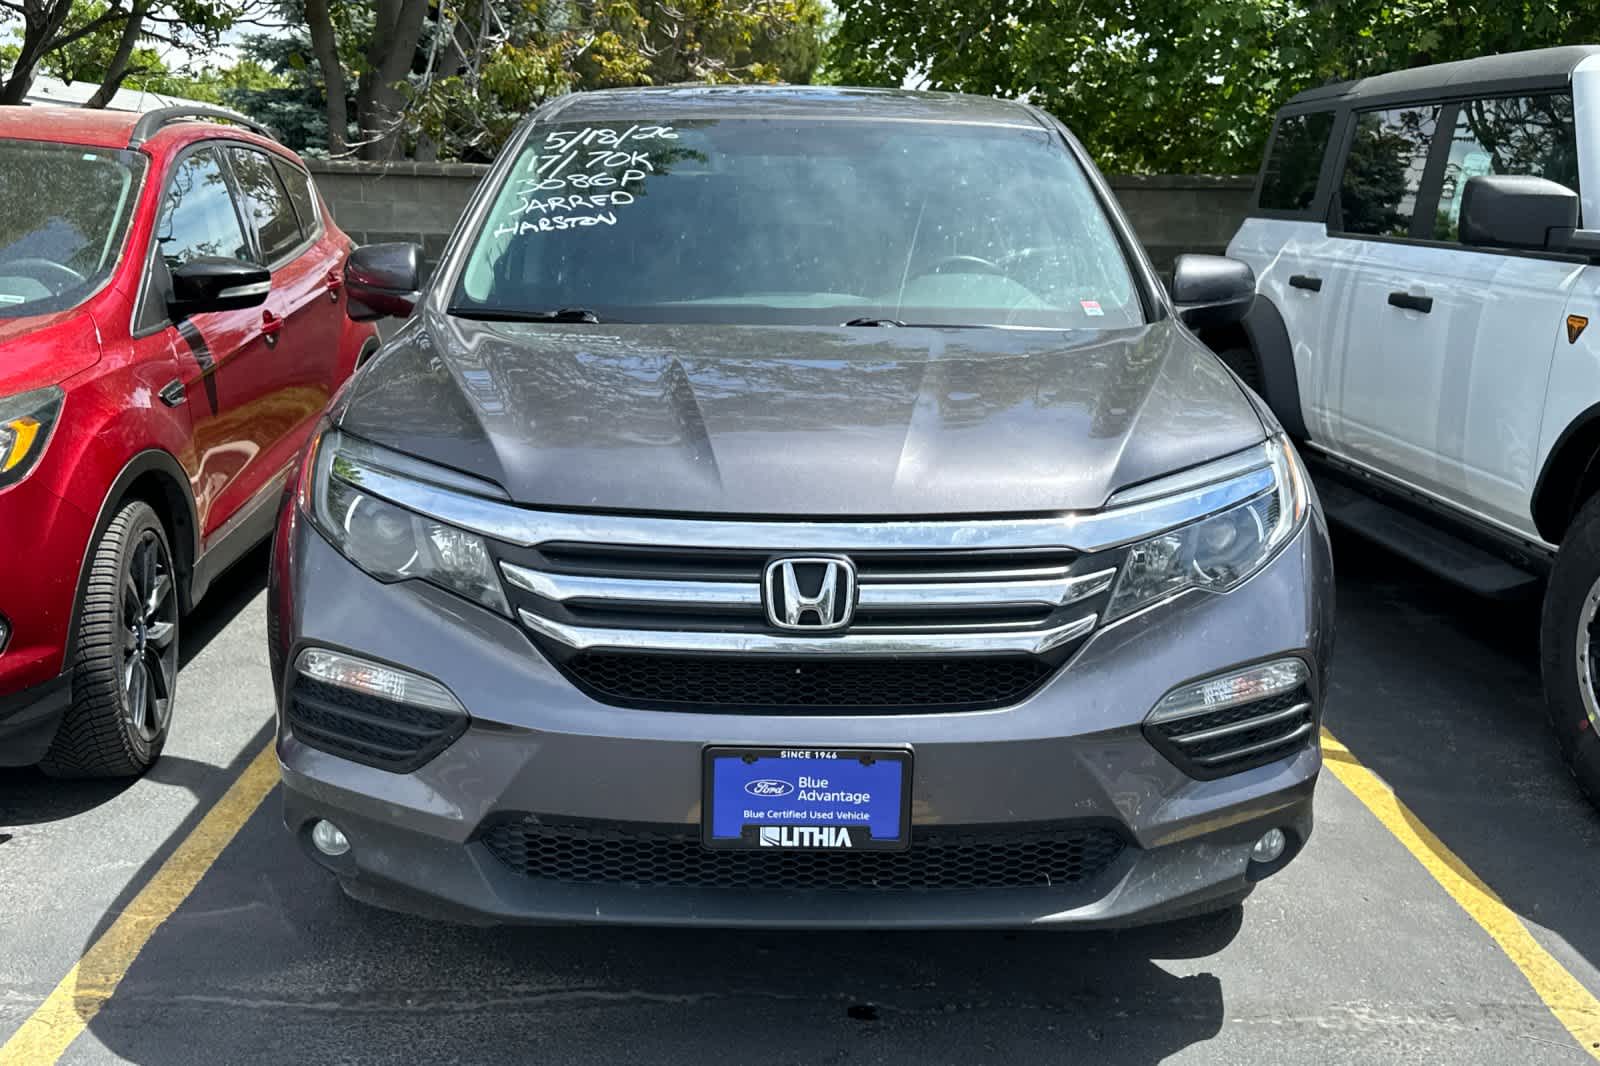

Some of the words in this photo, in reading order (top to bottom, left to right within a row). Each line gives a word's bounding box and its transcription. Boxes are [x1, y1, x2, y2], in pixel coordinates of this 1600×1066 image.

[544, 124, 679, 153] 5/18/26
[508, 190, 634, 215] JARRED
[780, 750, 811, 759] SINCE
[814, 751, 838, 760] 1946
[753, 782, 784, 795] Ford
[798, 776, 829, 789] Blue
[797, 790, 870, 805] Advantage
[743, 809, 765, 819] Blue
[767, 809, 807, 820] Certified
[809, 811, 834, 820] Used
[837, 811, 870, 821] Vehicle
[780, 826, 852, 847] LITHIA
